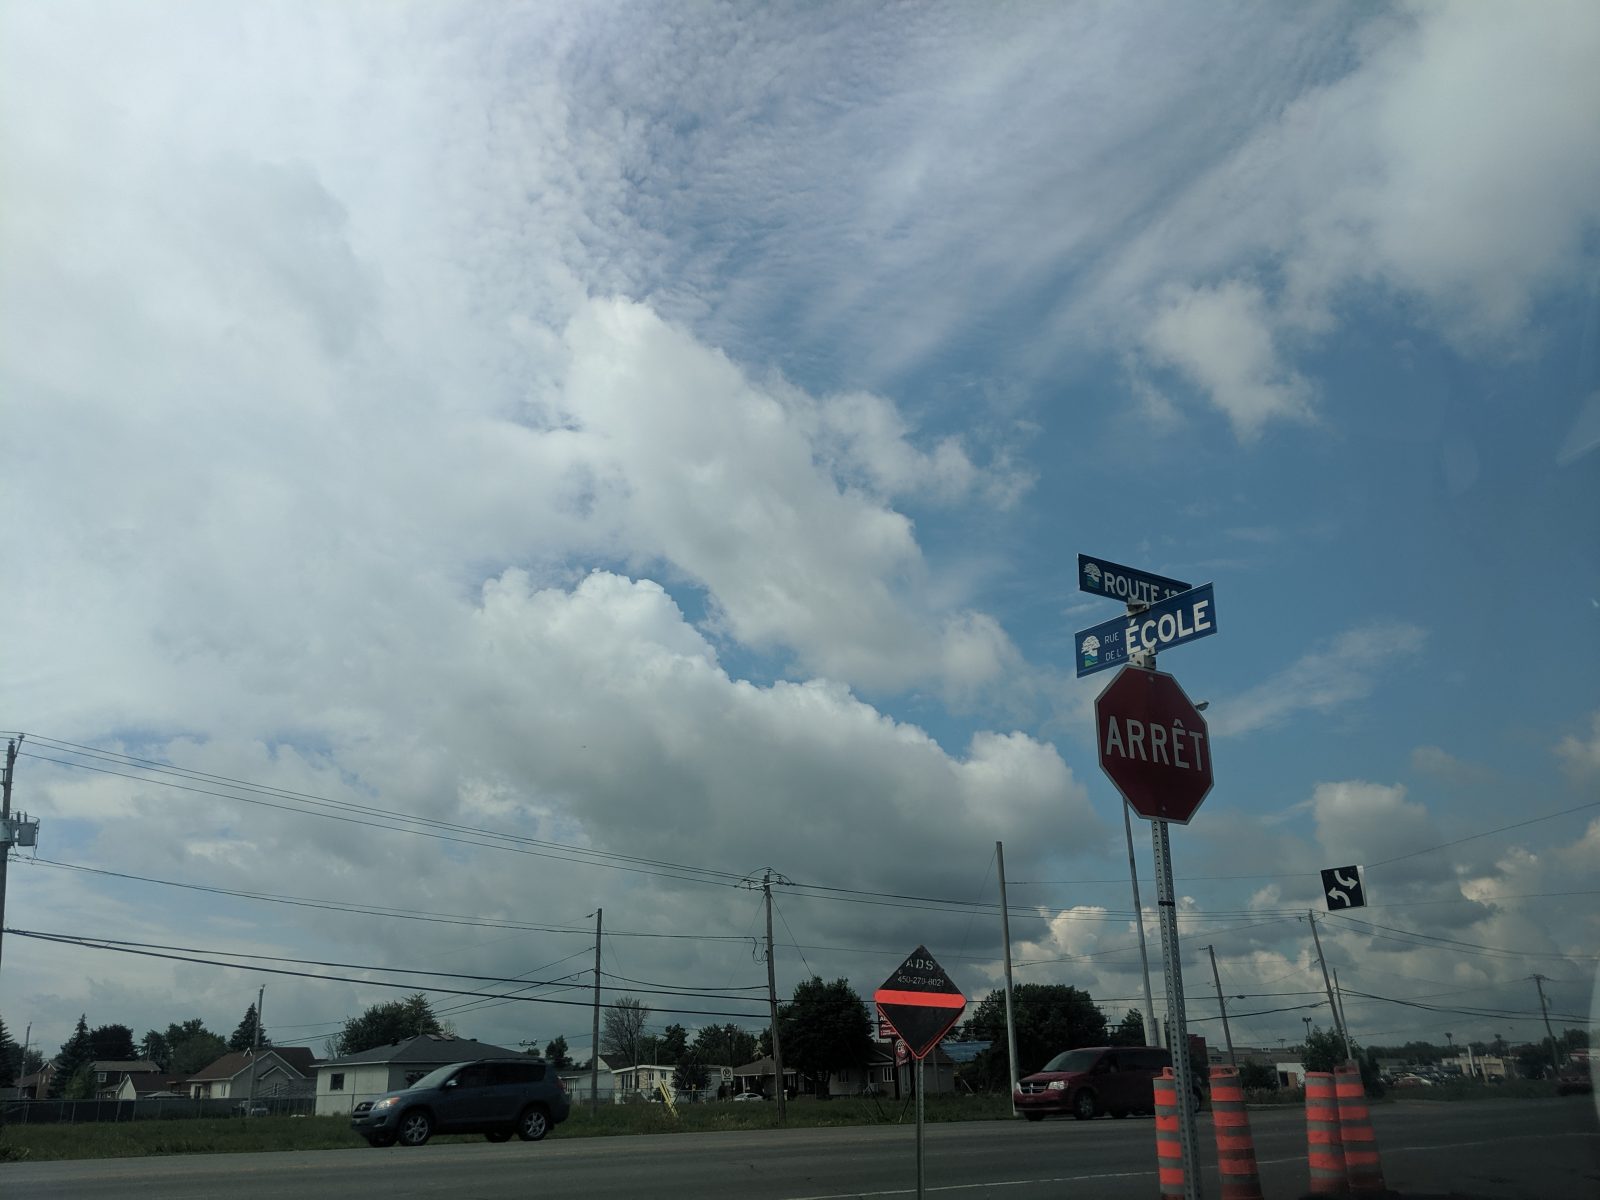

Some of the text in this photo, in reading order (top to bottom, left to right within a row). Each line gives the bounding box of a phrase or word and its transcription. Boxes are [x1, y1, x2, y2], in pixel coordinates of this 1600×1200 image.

[1103, 571, 1160, 602] ROUTE
[1104, 632, 1120, 645] RUE
[1125, 600, 1211, 655] ÉCOLE
[1105, 715, 1204, 771] ARRÊT
[905, 958, 934, 971] ADS
